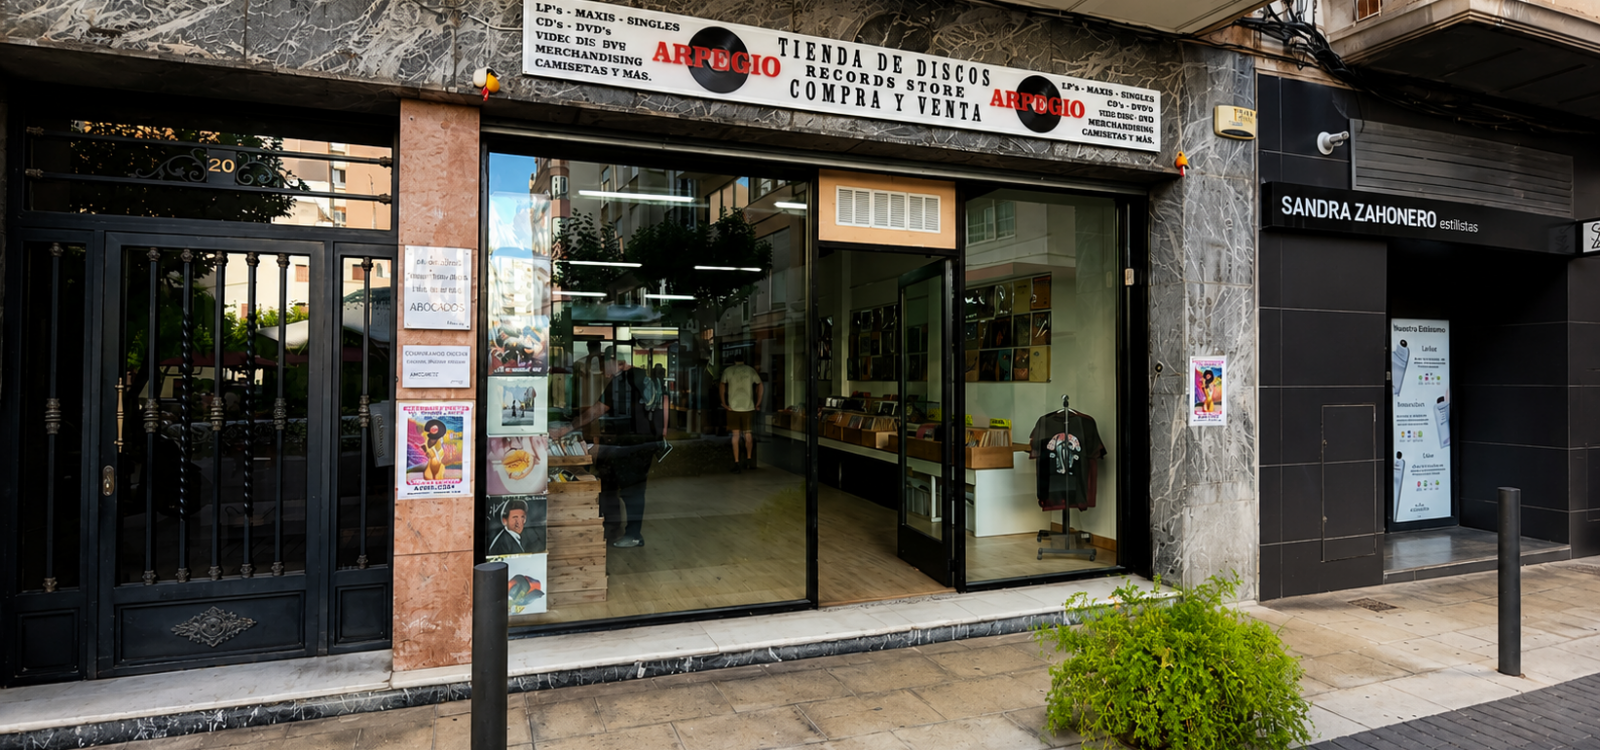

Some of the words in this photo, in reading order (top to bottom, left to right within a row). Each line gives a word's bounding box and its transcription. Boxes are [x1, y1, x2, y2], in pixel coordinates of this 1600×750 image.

[535, 3, 562, 14] LP's
[575, 8, 616, 22] MAXIS
[627, 16, 680, 32] SINGLES
[536, 17, 564, 29] CD's
[576, 22, 612, 36] DVD's
[534, 58, 608, 76] CAMISETAS
[611, 67, 620, 77] Y
[535, 44, 643, 66] MERCHANDISING
[652, 41, 781, 78] ARPEGIO
[778, 37, 862, 68] TIENDA
[877, 52, 902, 74] DE
[917, 58, 991, 87] DISCOS
[806, 65, 896, 89] RECORDS
[906, 79, 965, 98] STORE
[1062, 82, 1080, 91] LP's
[1086, 86, 1114, 96] MAXIS
[1121, 91, 1154, 102] SINGLES
[790, 78, 881, 109] COMPRA
[894, 93, 904, 112] Y
[918, 96, 982, 122] VENTA
[990, 88, 1085, 119] ARPEGIO
[1082, 128, 1127, 140] CAMISETAS
[1088, 118, 1154, 134] MERCHANDISING
[208, 158, 235, 173] 20
[1281, 195, 1352, 221] SANDRA
[1354, 202, 1436, 229] ZAHONERO
[1440, 218, 1478, 233] estilistas
